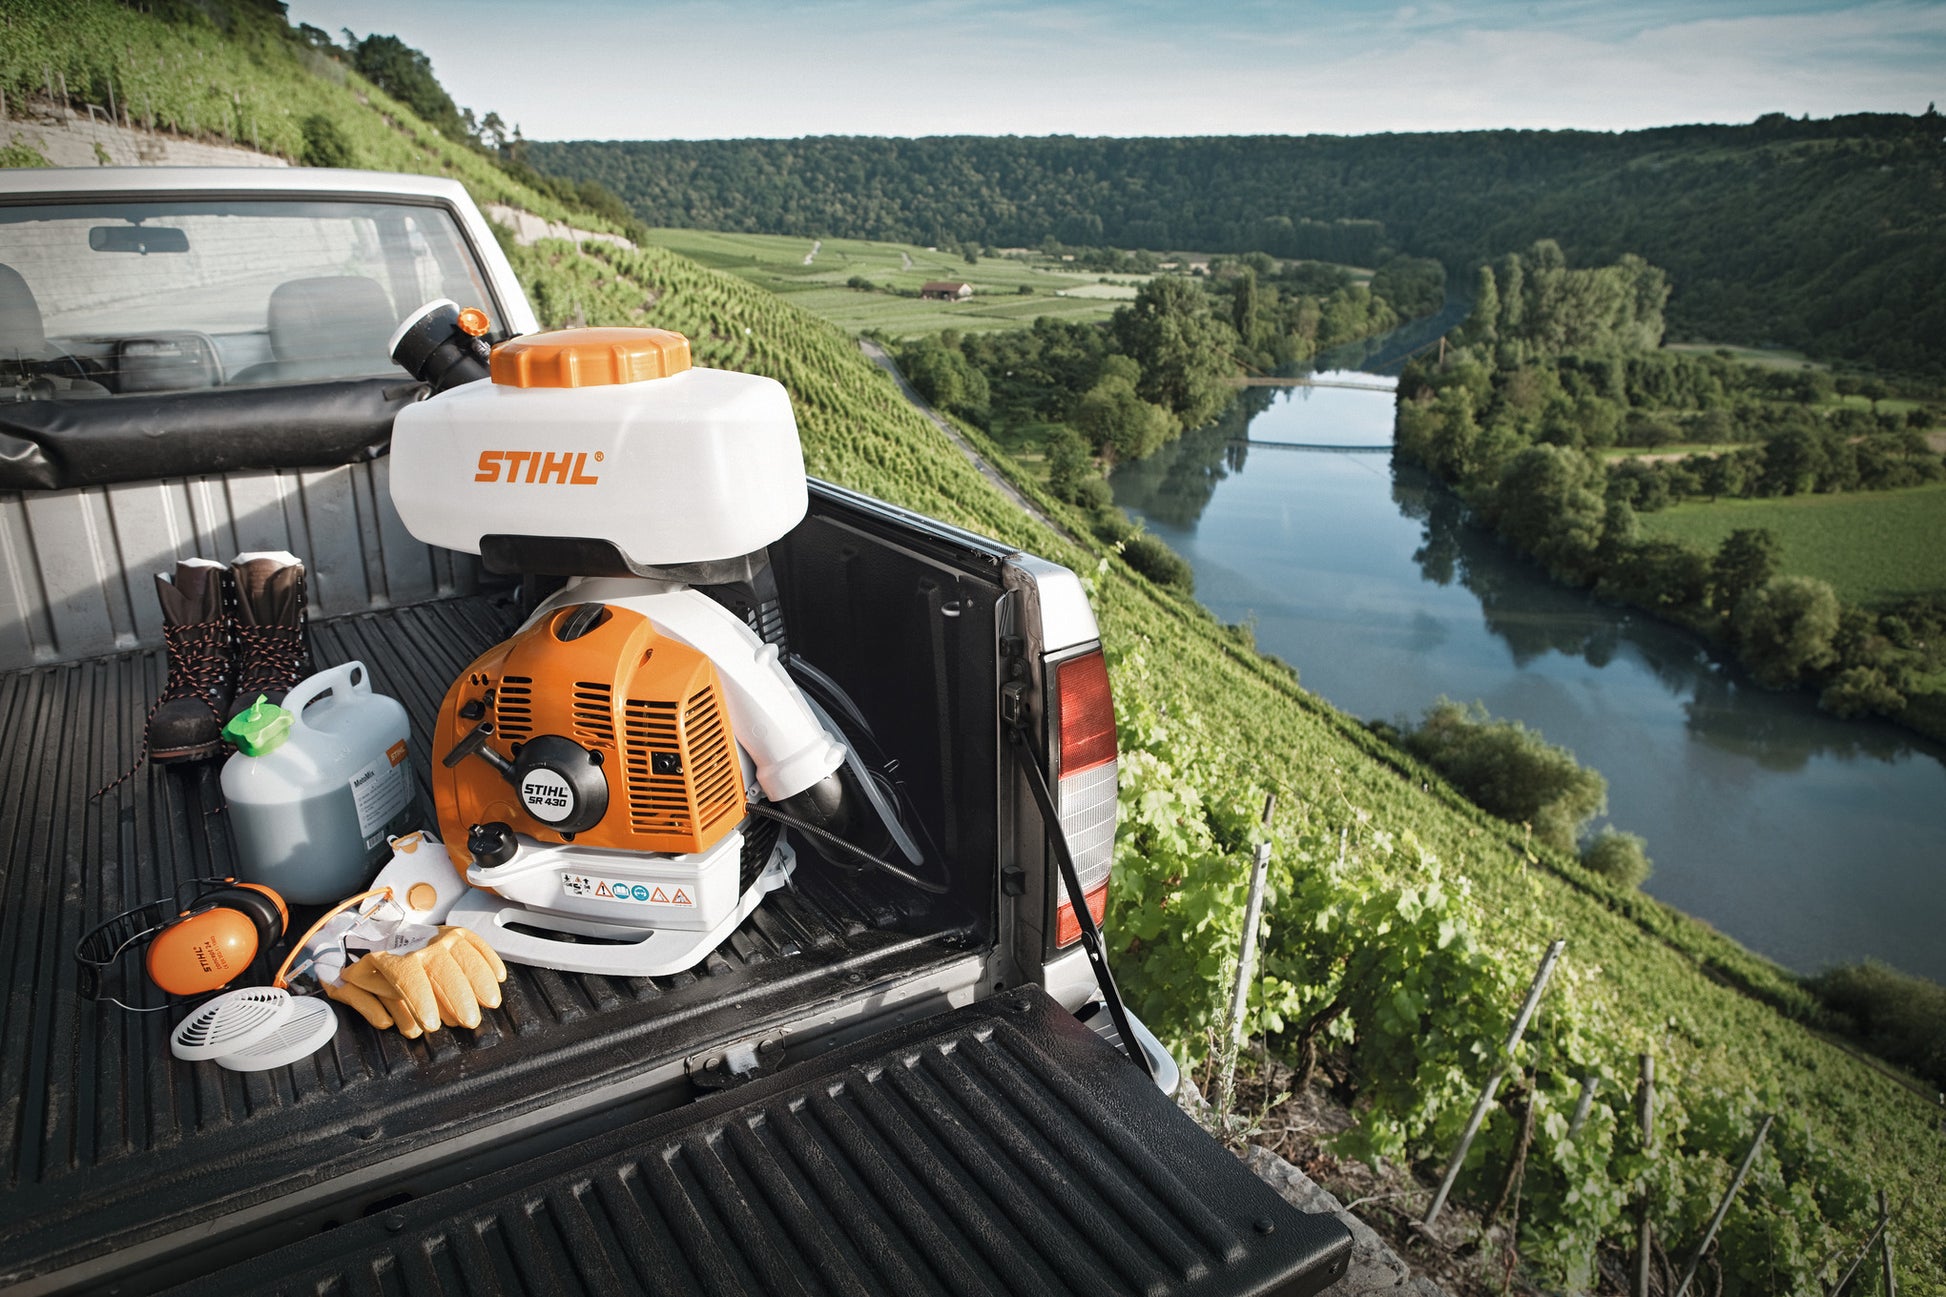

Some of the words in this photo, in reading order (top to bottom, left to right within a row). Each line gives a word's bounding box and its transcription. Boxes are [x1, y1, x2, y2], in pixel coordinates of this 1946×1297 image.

[353, 769, 375, 788] MotoMix
[528, 796, 543, 805] SR
[544, 797, 567, 807] 430
